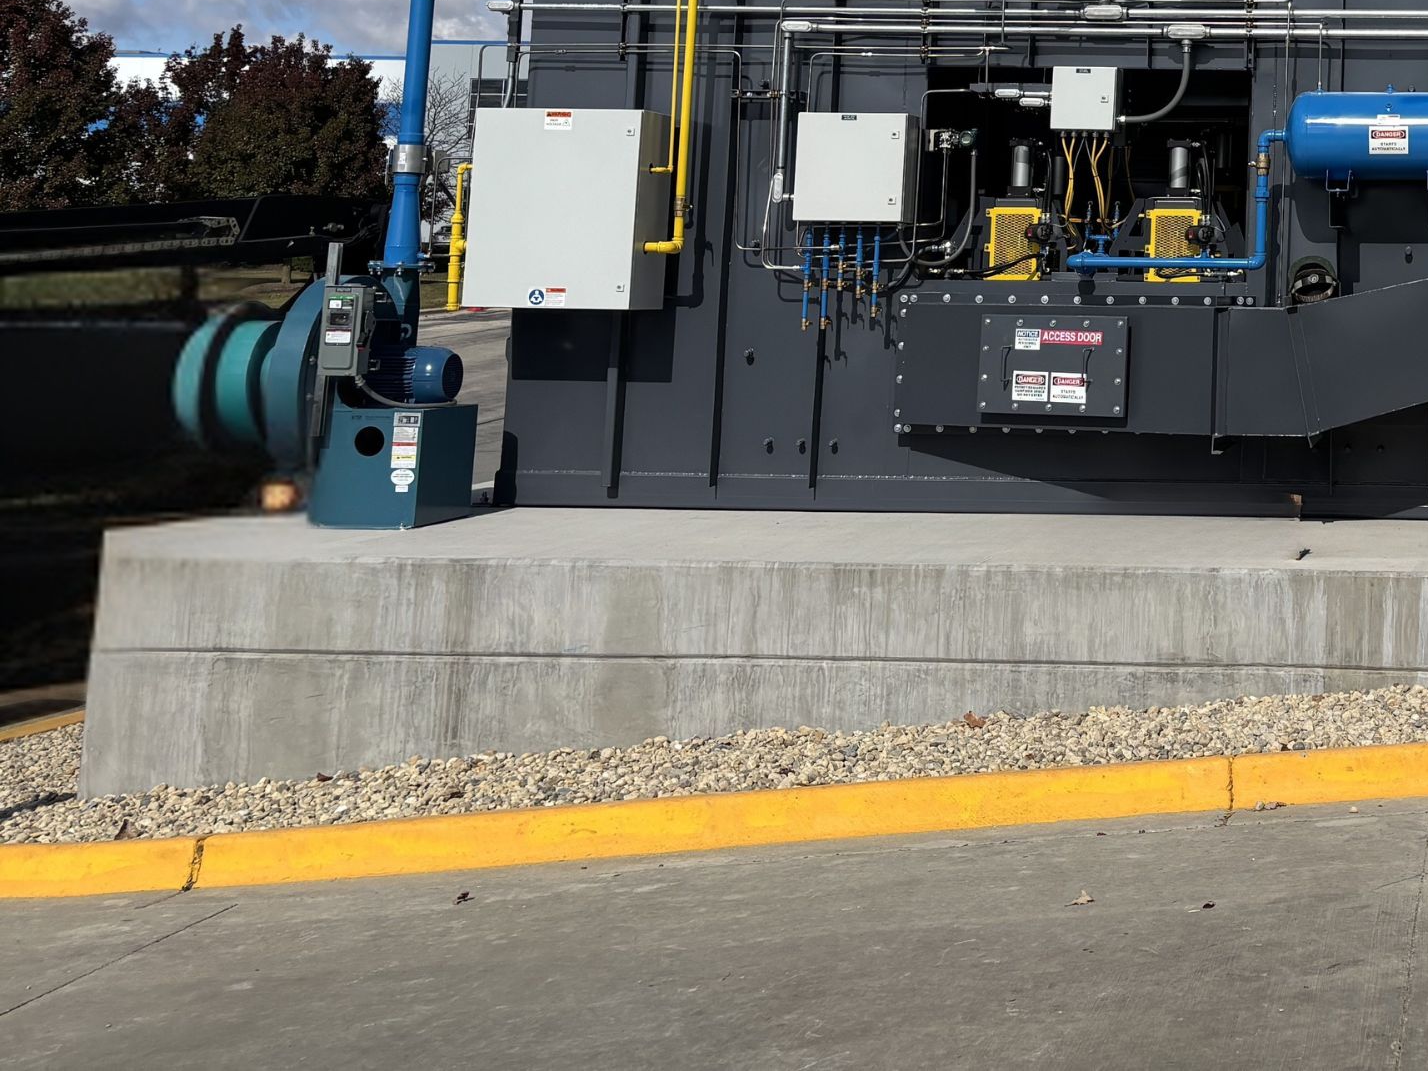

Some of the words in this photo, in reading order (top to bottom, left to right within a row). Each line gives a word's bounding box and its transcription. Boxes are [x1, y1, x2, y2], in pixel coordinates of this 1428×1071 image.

[1042, 331, 1076, 342] ACCESS
[1078, 332, 1102, 342] DOOR
[1018, 376, 1043, 384] DANGER
